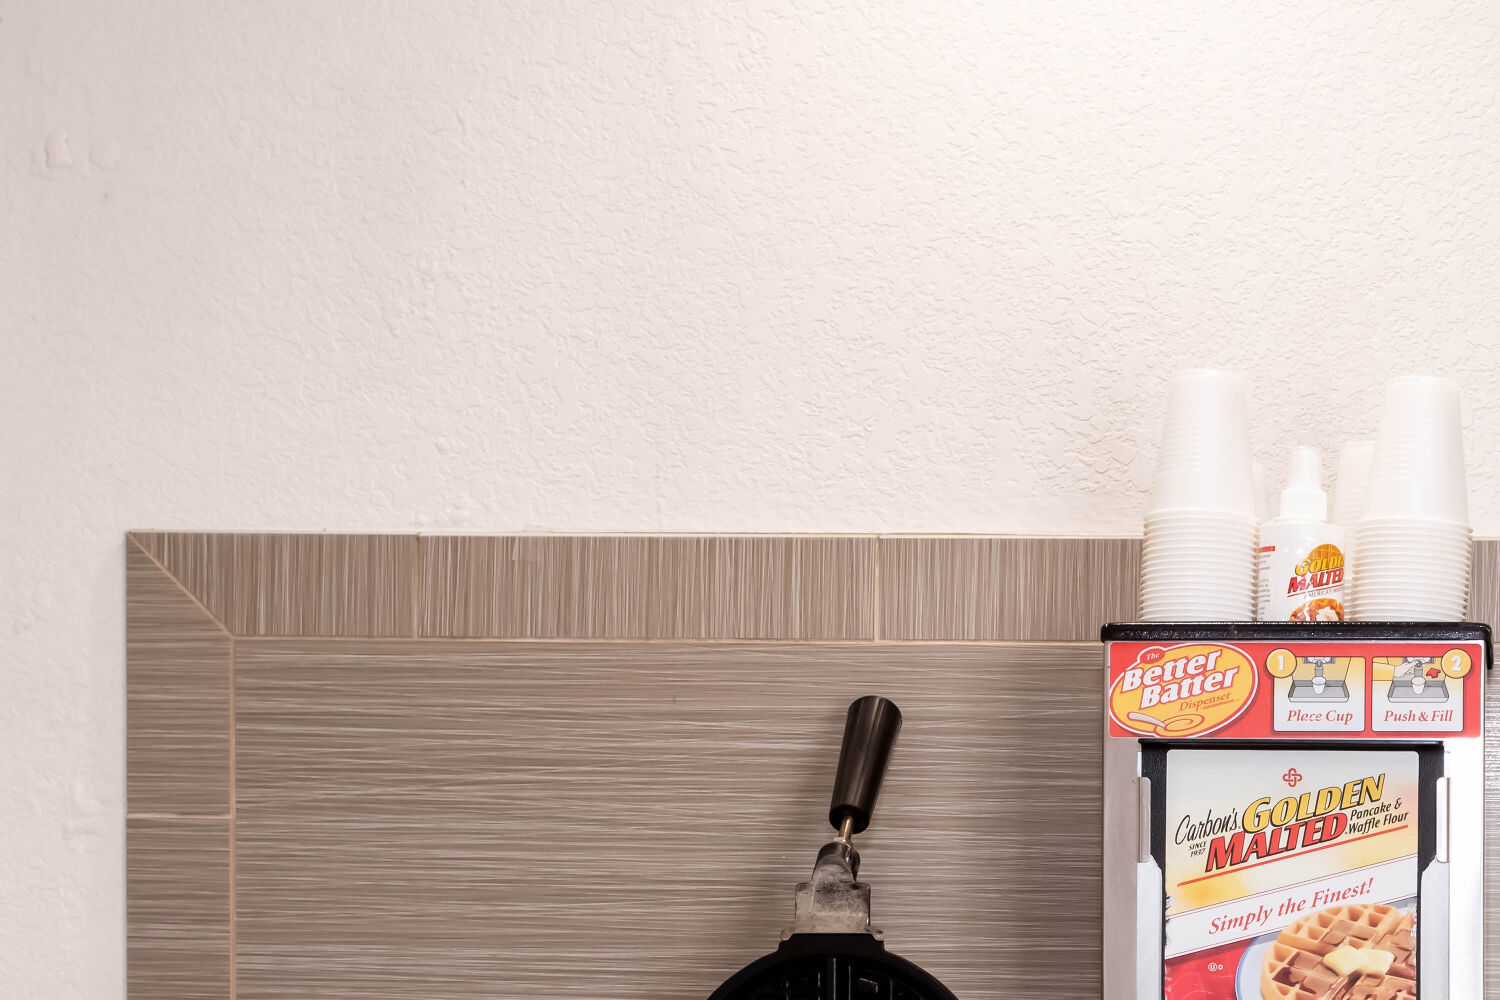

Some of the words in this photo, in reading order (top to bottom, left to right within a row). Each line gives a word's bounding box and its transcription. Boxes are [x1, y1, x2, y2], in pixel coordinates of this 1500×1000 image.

[1145, 652, 1160, 661] The
[1277, 654, 1285, 671] 1
[1451, 655, 1462, 671] 2
[1121, 649, 1222, 694] Better
[1139, 665, 1240, 710] Batter
[1179, 692, 1232, 711] Dispenser
[1287, 709, 1323, 723] Place
[1325, 709, 1354, 724] Cup
[1384, 709, 1416, 723] Push
[1419, 711, 1429, 722] &
[1431, 708, 1454, 723] Fill
[1175, 807, 1239, 845] Carbon's
[1242, 773, 1386, 834] GOLDEN
[1350, 802, 1392, 821] Pancake
[1394, 797, 1402, 809] &
[1349, 817, 1380, 835] Waffle
[1383, 811, 1409, 829] Flour
[1189, 841, 1207, 851] SINCE
[1205, 812, 1348, 872] MALTED
[1190, 848, 1206, 857] 1937
[1208, 906, 1273, 935] Simply
[1277, 897, 1309, 917] the
[1311, 877, 1374, 908] Finest!
